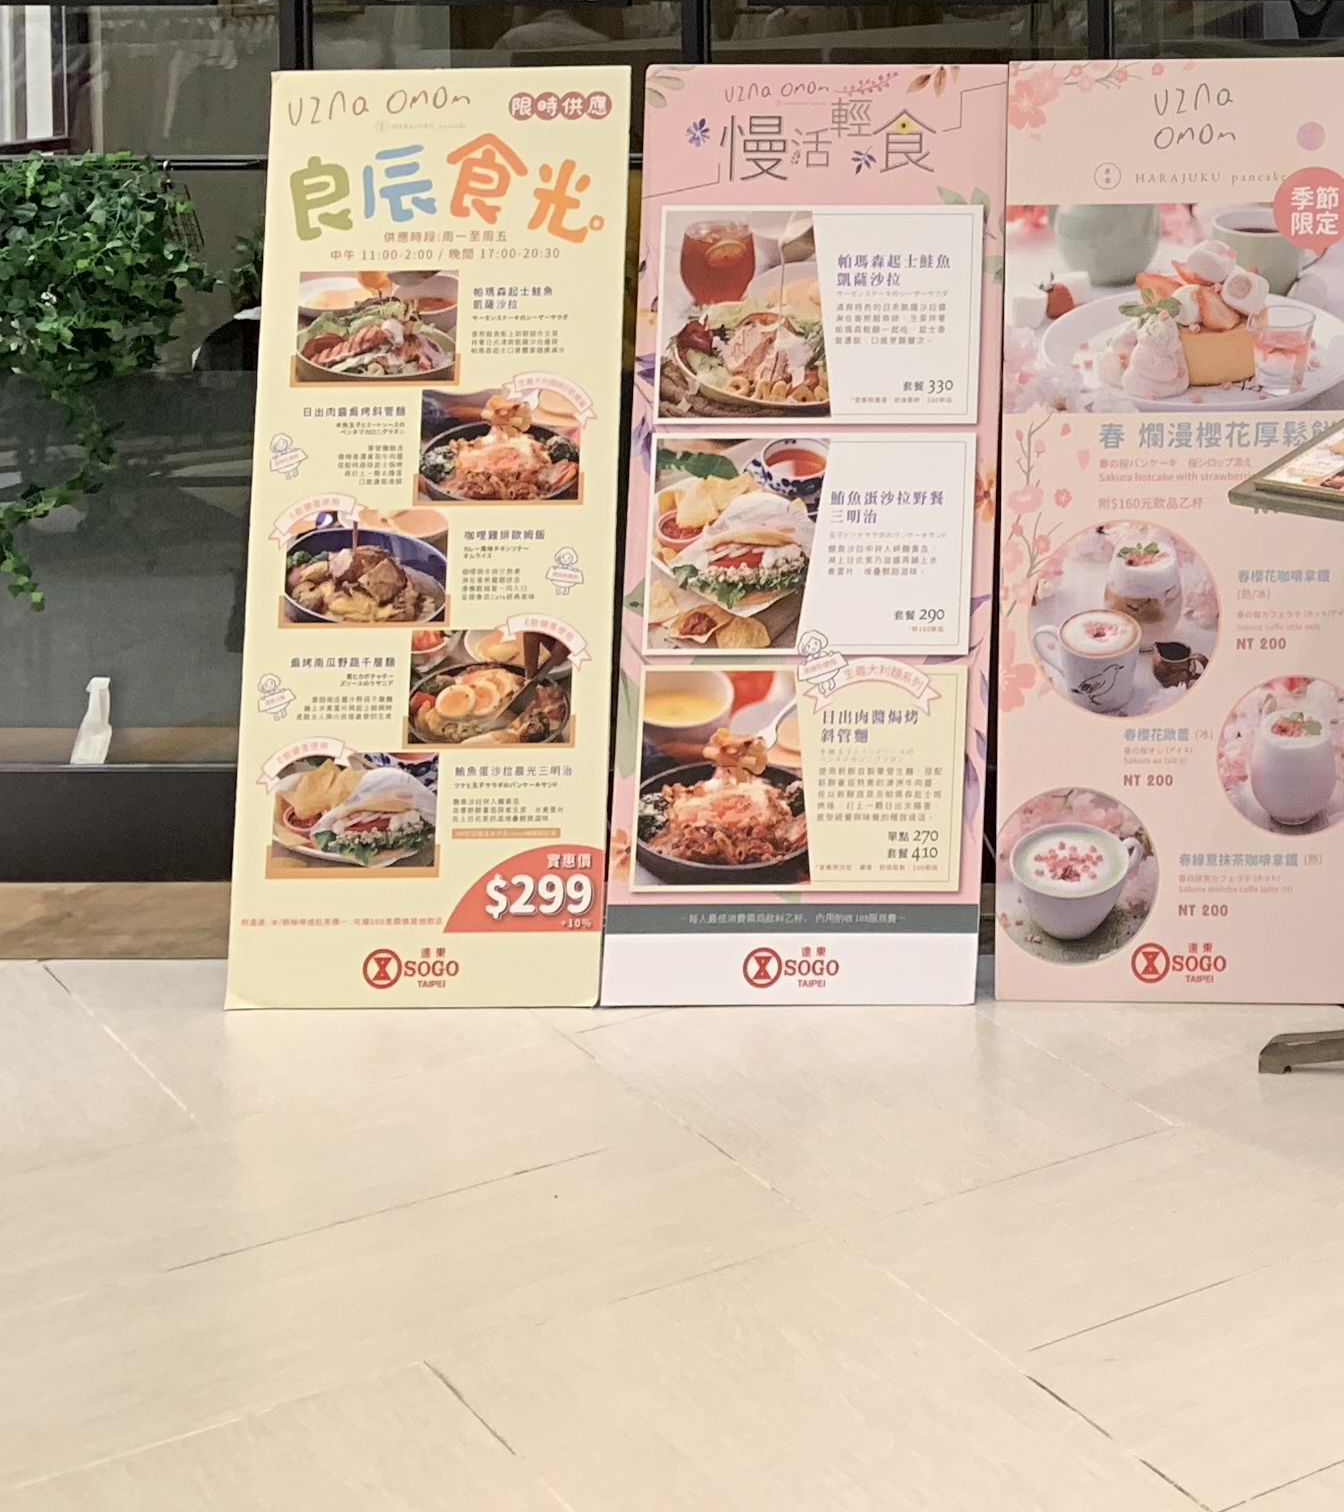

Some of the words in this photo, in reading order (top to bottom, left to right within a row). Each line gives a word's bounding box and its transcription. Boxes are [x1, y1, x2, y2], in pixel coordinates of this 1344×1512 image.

[511, 92, 608, 116] 限時供應
[1135, 172, 1222, 185] HARAJUKU
[1290, 186, 1339, 210] 季節
[1290, 212, 1339, 236] 限定
[928, 379, 954, 394] 330
[830, 509, 877, 524] 三明治
[919, 608, 945, 623] 290
[1237, 638, 1254, 649] NT
[1260, 638, 1287, 649] 200
[1123, 774, 1141, 786] NT
[1147, 774, 1173, 786] 200
[913, 830, 939, 845] 270
[912, 847, 938, 862] 410
[485, 874, 594, 919] $299
[1178, 904, 1196, 916] NT
[1202, 904, 1228, 916] 200
[403, 960, 459, 977] SOGO
[784, 960, 839, 977] SOGO
[1172, 955, 1226, 973] SOGO
[417, 980, 446, 988] TAIPEI
[797, 980, 826, 988] TAIPEI
[1185, 976, 1214, 984] TAIPEI
